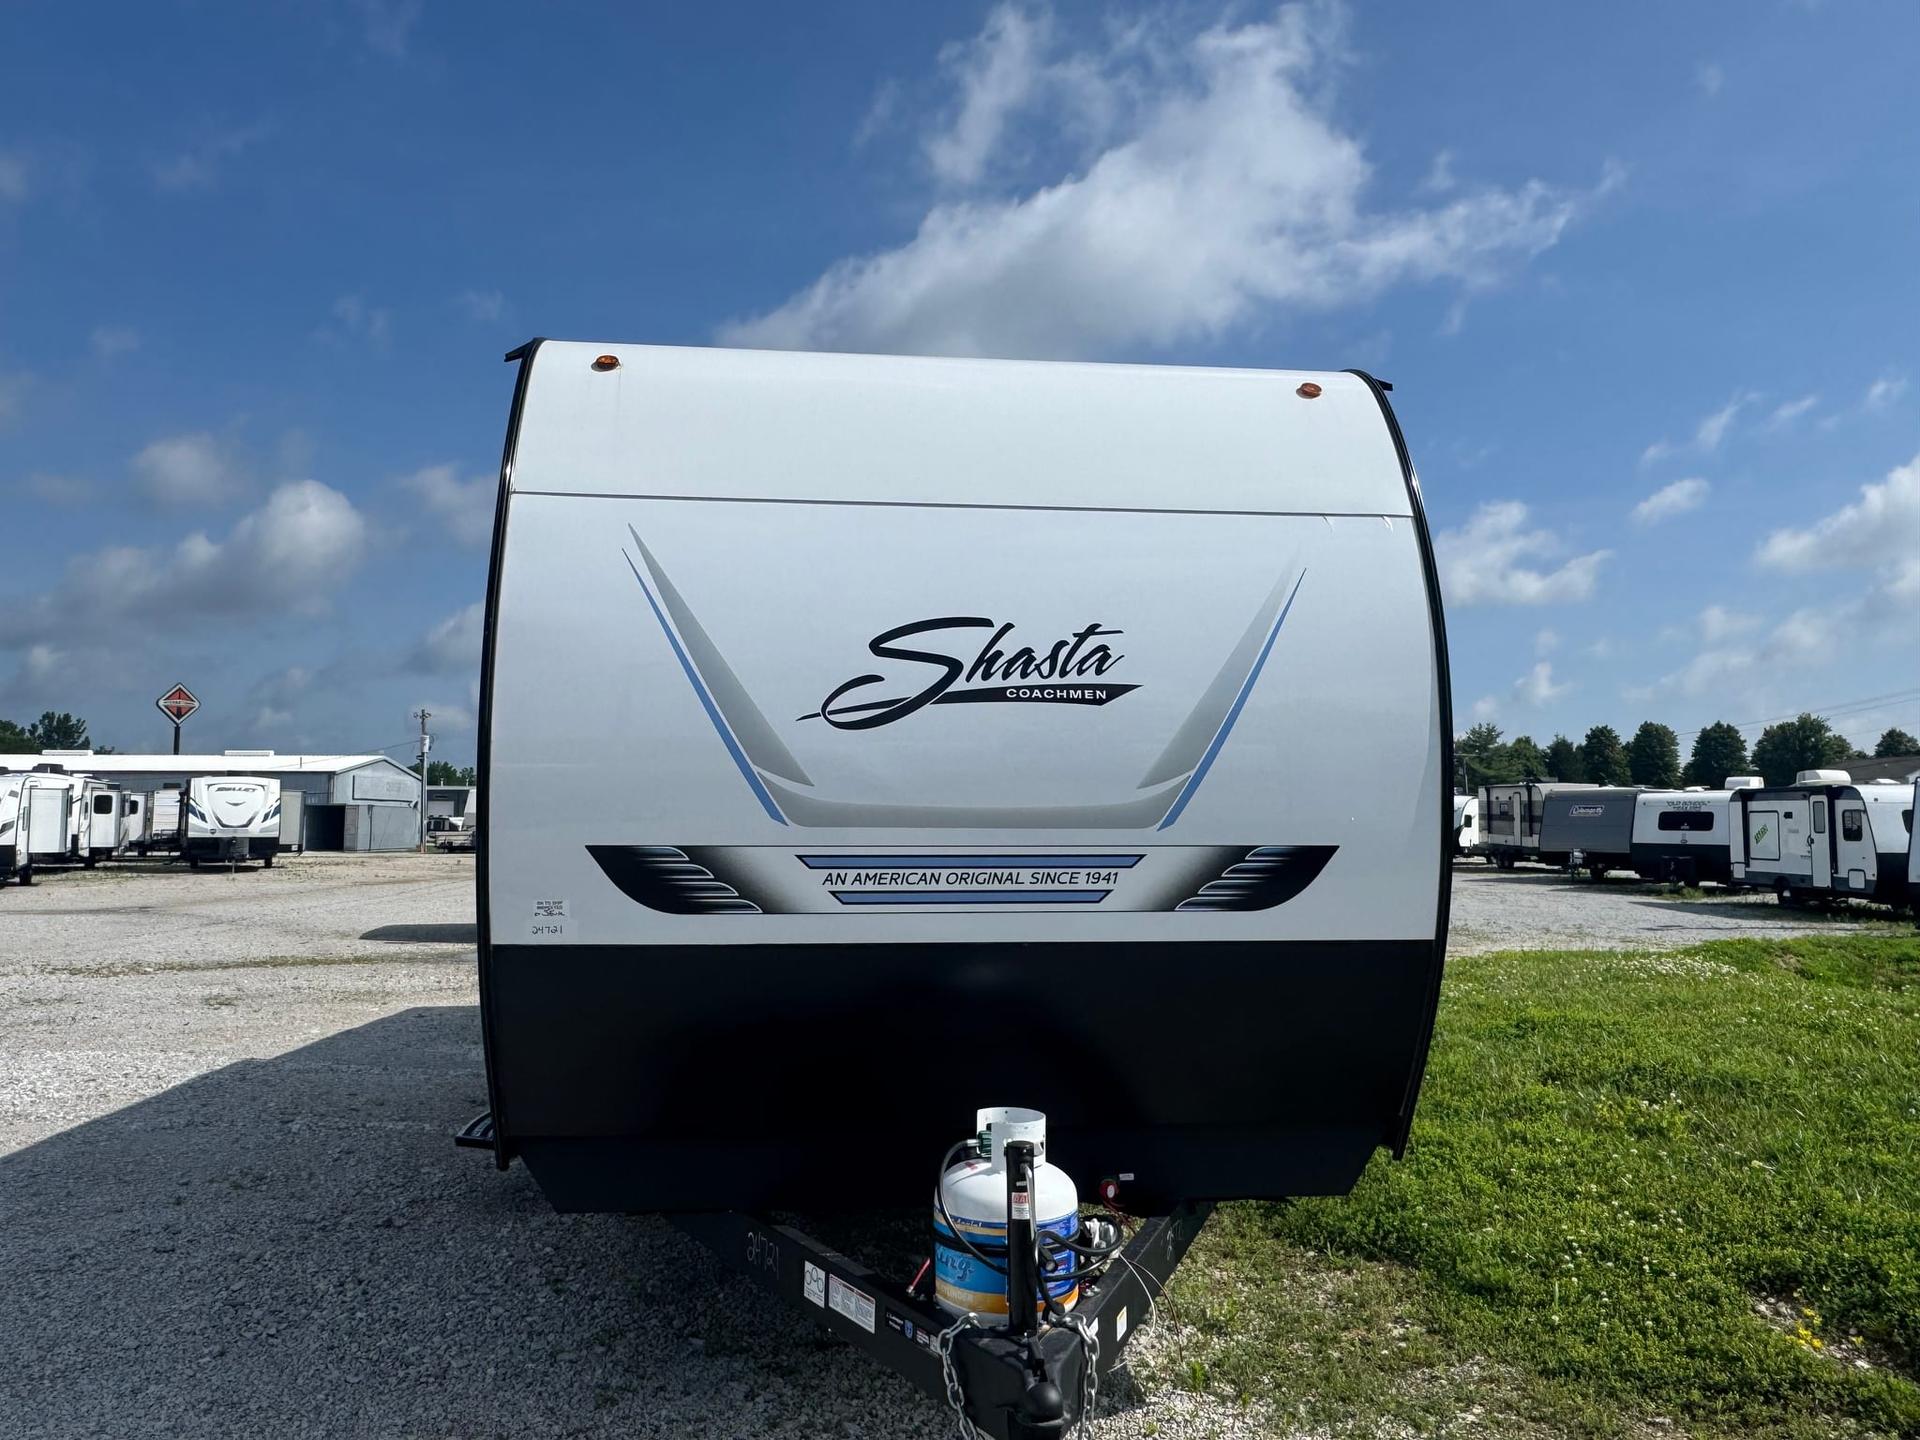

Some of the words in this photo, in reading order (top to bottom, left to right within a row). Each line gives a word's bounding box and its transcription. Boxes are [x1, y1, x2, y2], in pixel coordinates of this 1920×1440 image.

[820, 616, 1125, 731] Shasta
[1005, 687, 1107, 701] COACHMEN
[822, 872, 847, 886] AN
[851, 872, 942, 886] AMERICAN
[945, 871, 1025, 886] ORIGINAL
[1028, 871, 1079, 885] SINCE
[1085, 871, 1119, 885] 1941
[531, 925, 563, 935] 24721
